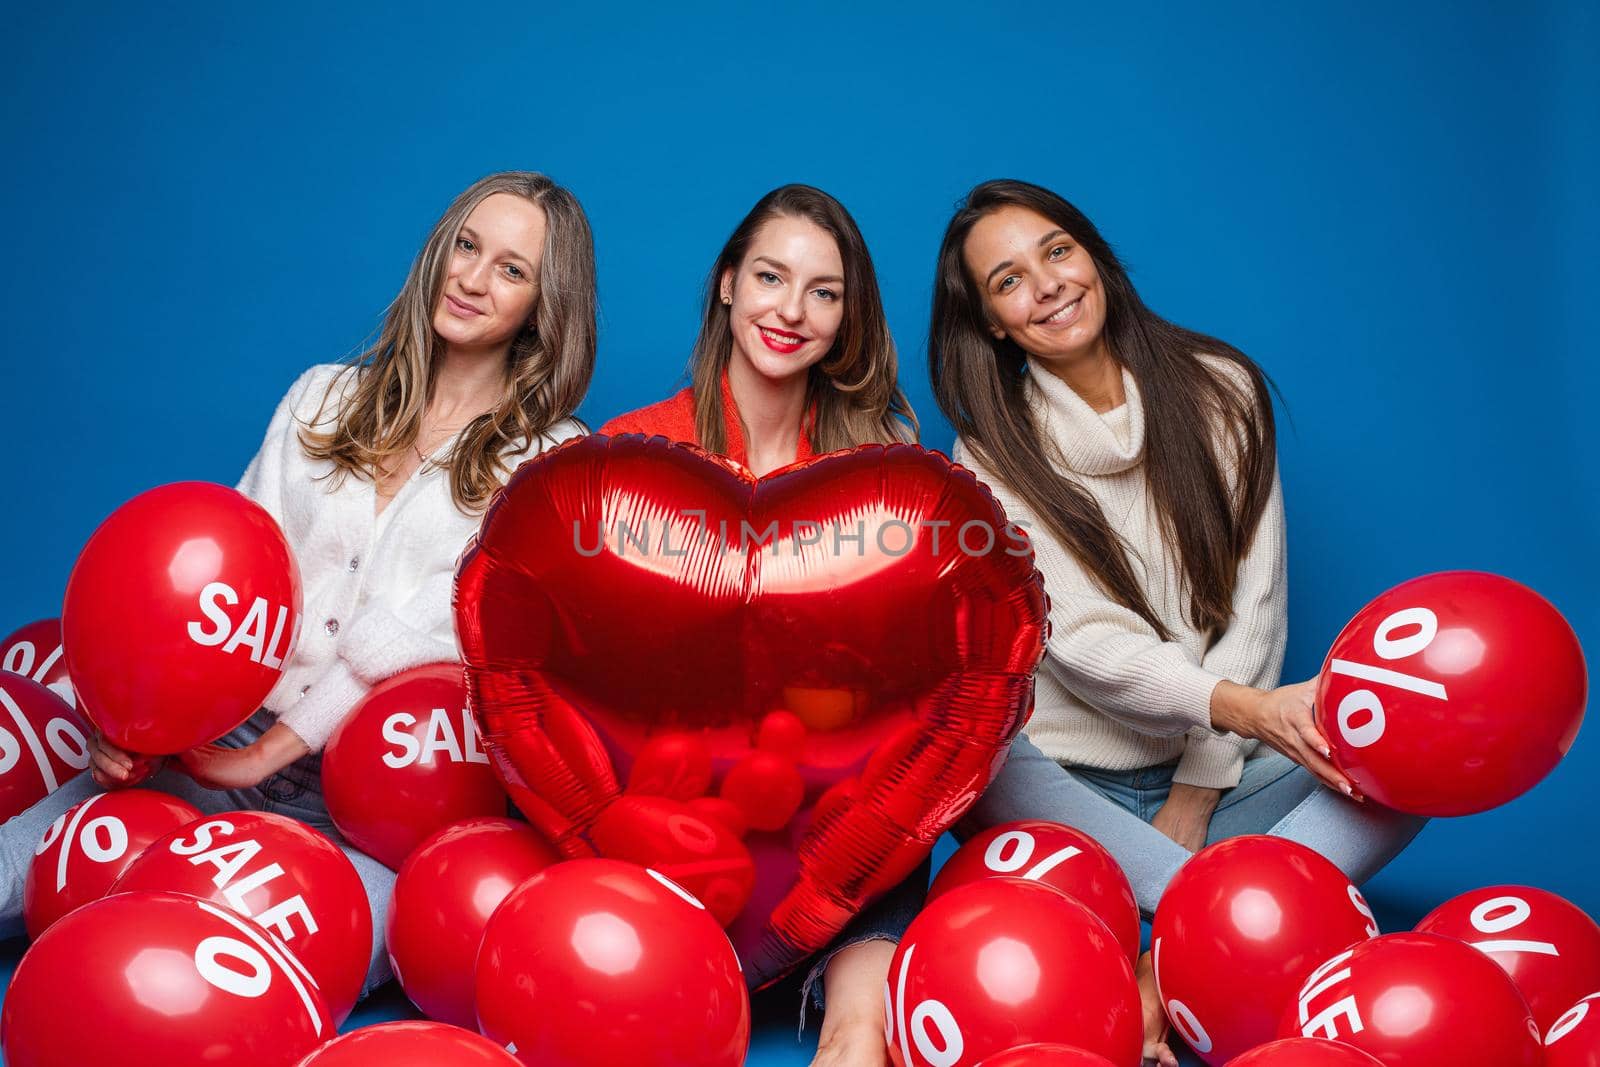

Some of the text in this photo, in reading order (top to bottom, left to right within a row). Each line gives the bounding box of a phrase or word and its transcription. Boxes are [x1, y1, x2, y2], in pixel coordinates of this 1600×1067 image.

[187, 582, 301, 671] SAL
[1331, 607, 1448, 747] %
[382, 708, 491, 769] SAL
[35, 792, 128, 893] %
[169, 820, 319, 942] SALE
